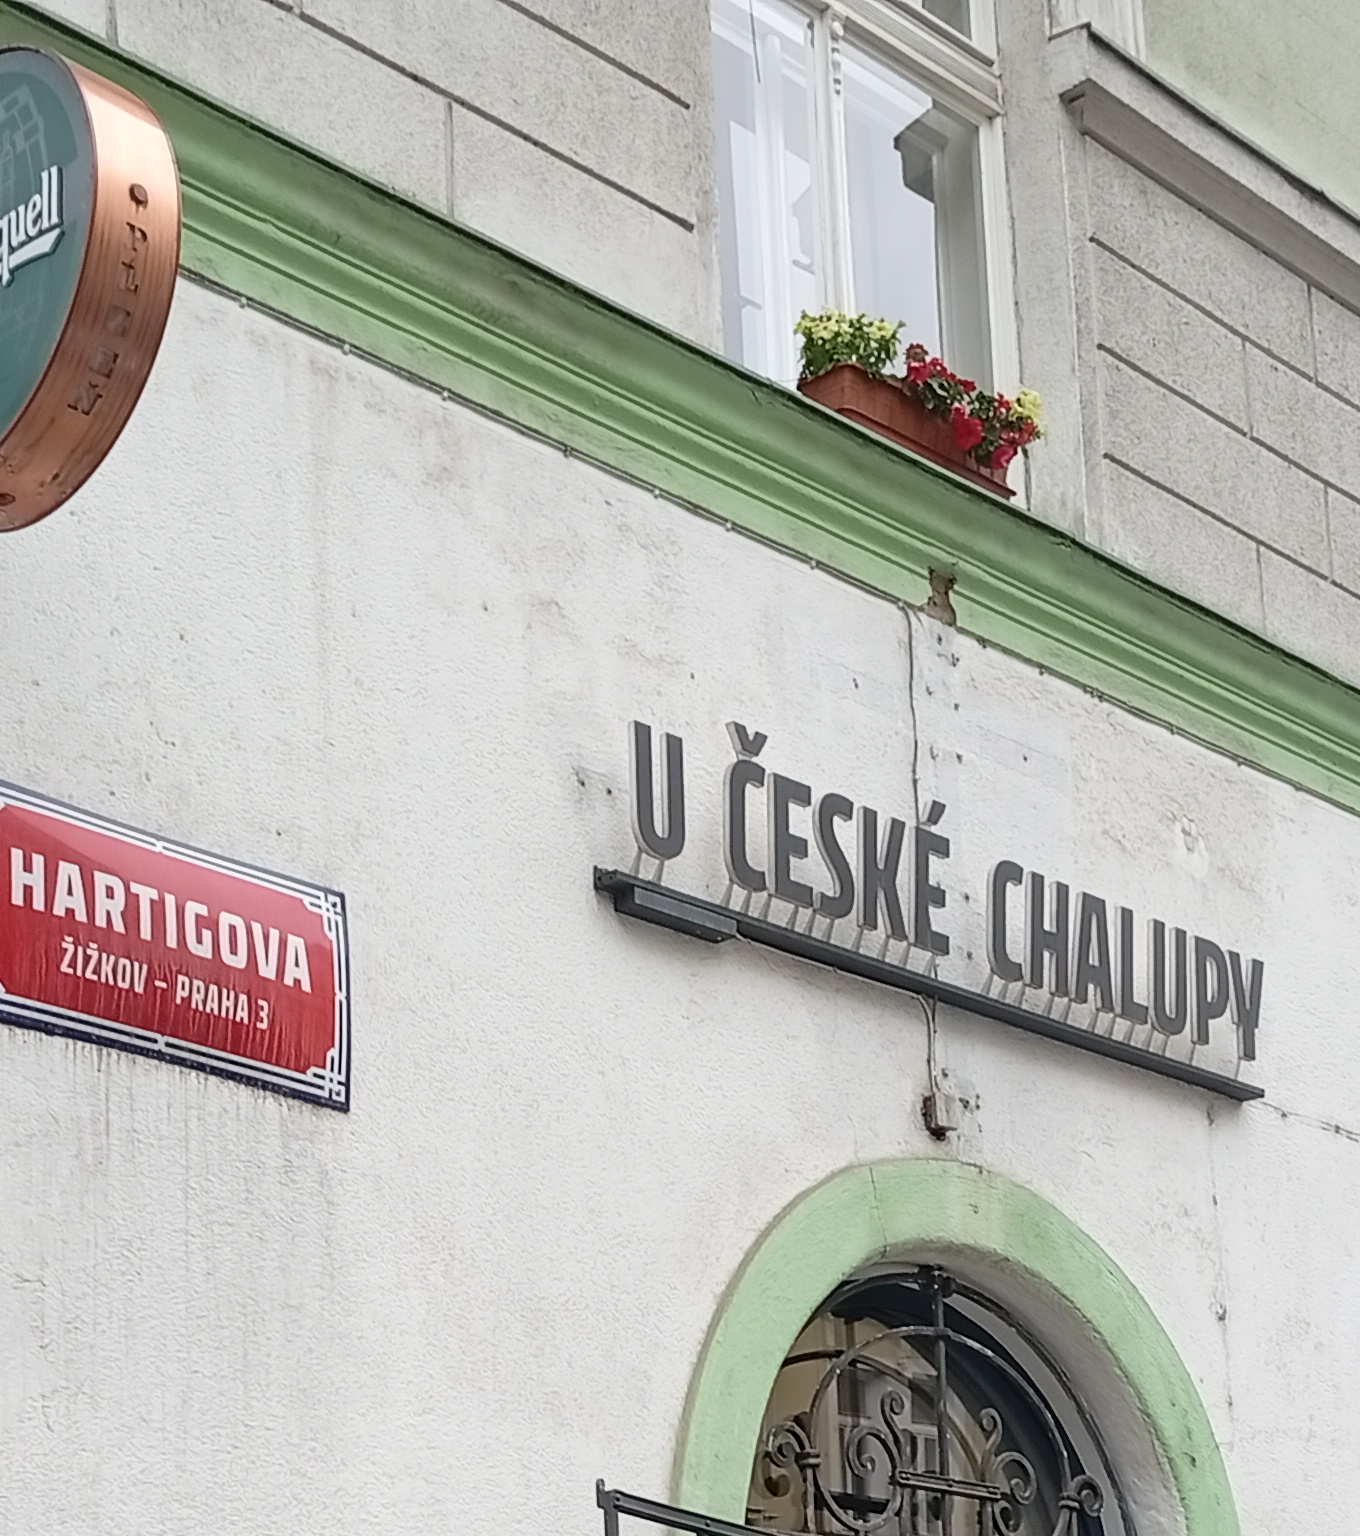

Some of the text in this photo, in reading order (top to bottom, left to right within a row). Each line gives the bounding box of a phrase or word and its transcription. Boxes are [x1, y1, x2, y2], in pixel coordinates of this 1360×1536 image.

[10, 846, 313, 994] HARTIGOVA
[628, 719, 1264, 1062] U ČESKÉ CHALUPY
[60, 935, 149, 995] ŽIŽKOV
[175, 974, 250, 1026] PRAHA
[256, 998, 270, 1031] 3
